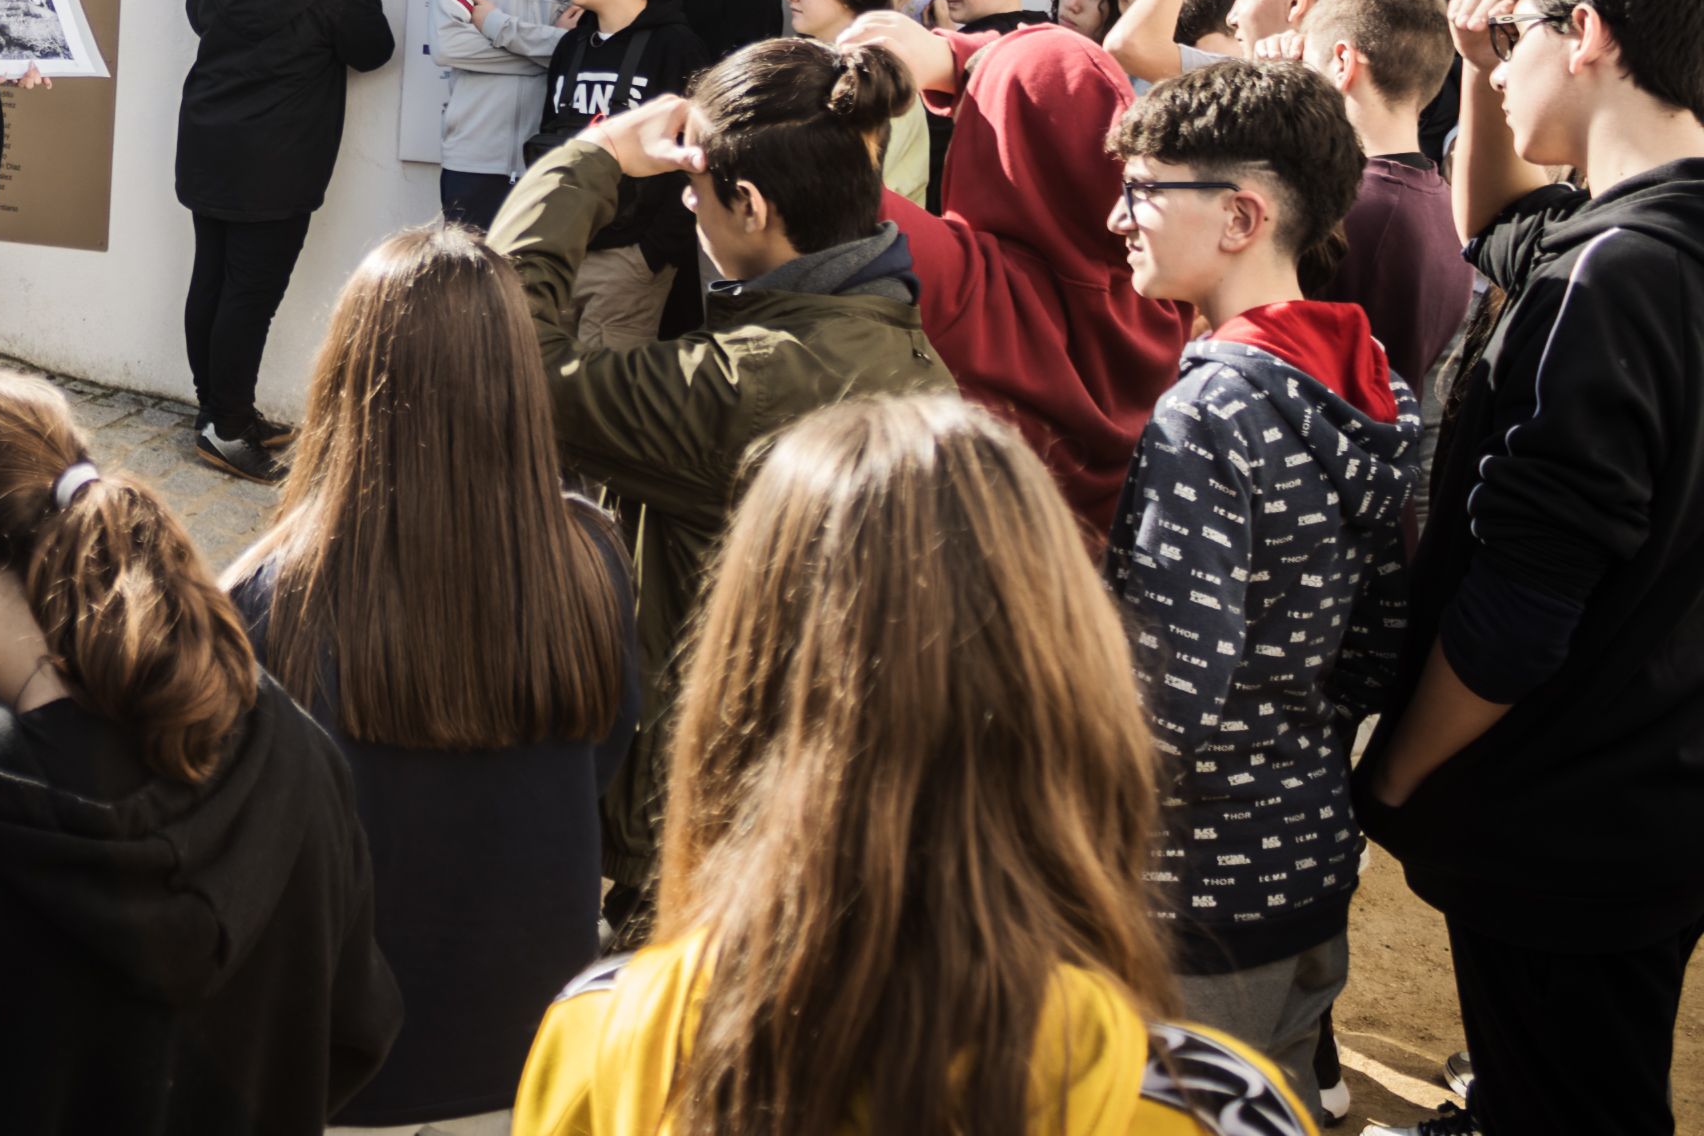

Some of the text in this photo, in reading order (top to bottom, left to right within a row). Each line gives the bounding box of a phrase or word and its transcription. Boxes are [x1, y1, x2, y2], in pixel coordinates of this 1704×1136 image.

[1168, 624, 1201, 641] THOR
[1223, 812, 1252, 820] THOR
[1202, 877, 1235, 886] THOR
